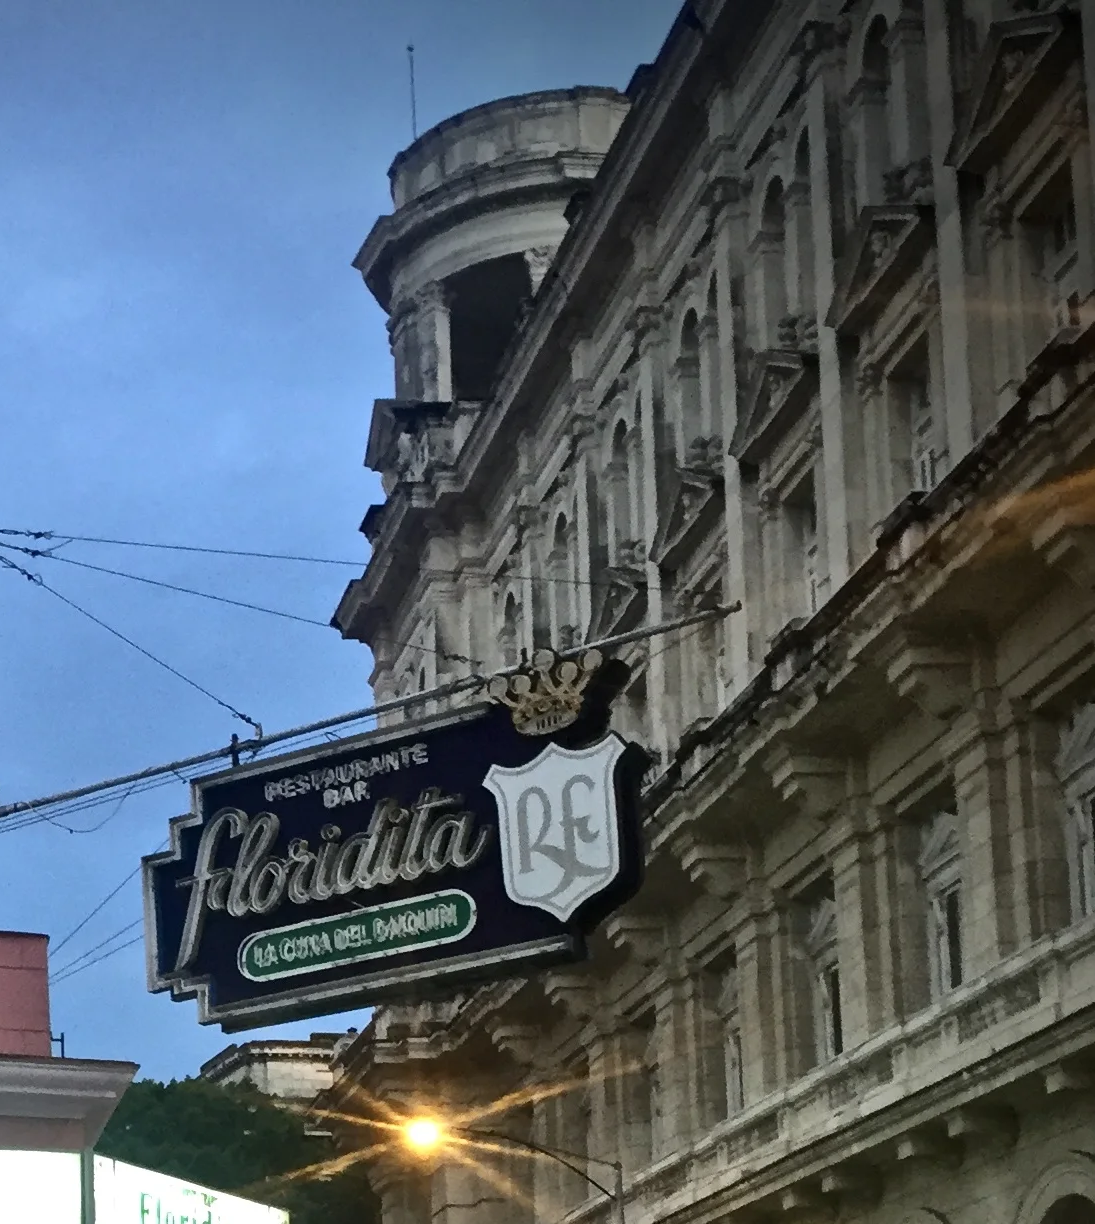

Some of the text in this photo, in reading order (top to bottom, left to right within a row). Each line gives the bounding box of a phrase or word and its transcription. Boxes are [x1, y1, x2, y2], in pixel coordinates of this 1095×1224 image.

[264, 743, 429, 802] RESTAURANTE
[322, 780, 371, 808] BAR
[253, 943, 278, 968] LA
[333, 924, 372, 950] DEL
